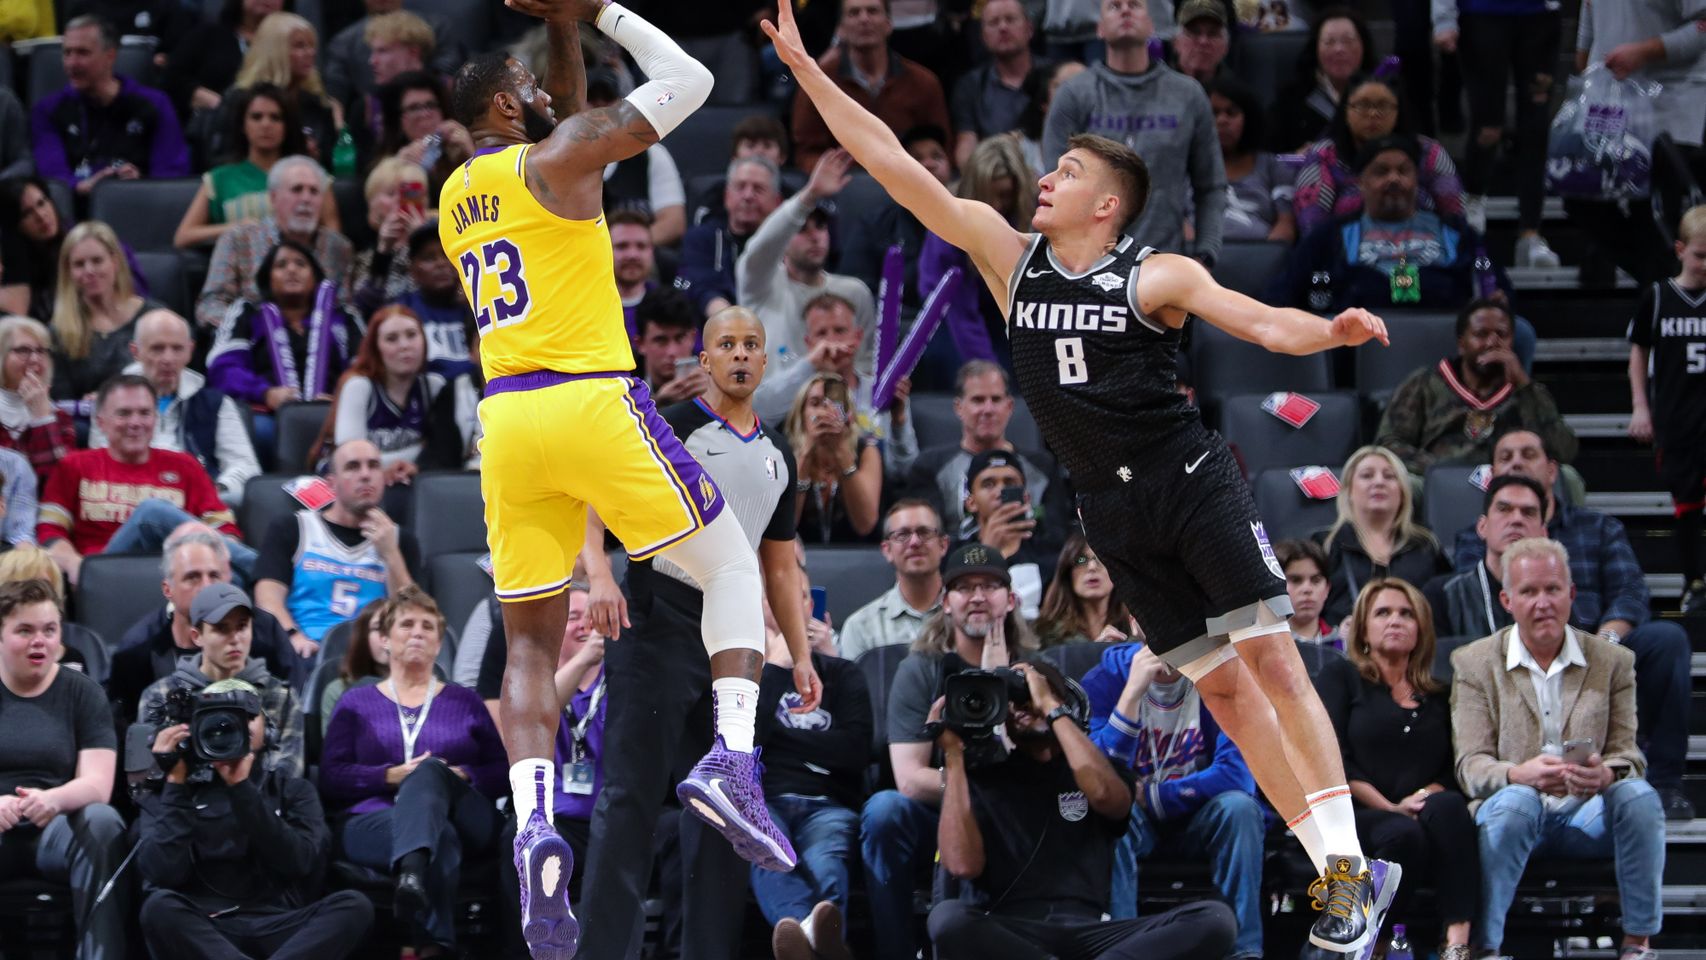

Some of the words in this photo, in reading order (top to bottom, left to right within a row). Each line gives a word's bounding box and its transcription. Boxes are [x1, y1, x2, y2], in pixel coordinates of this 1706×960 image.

[451, 193, 500, 235] JAMES
[459, 237, 533, 337] 23
[1016, 301, 1128, 332] KINGS
[1661, 317, 1706, 337] KIN
[1055, 337, 1088, 385] 8
[331, 579, 360, 618] 5
